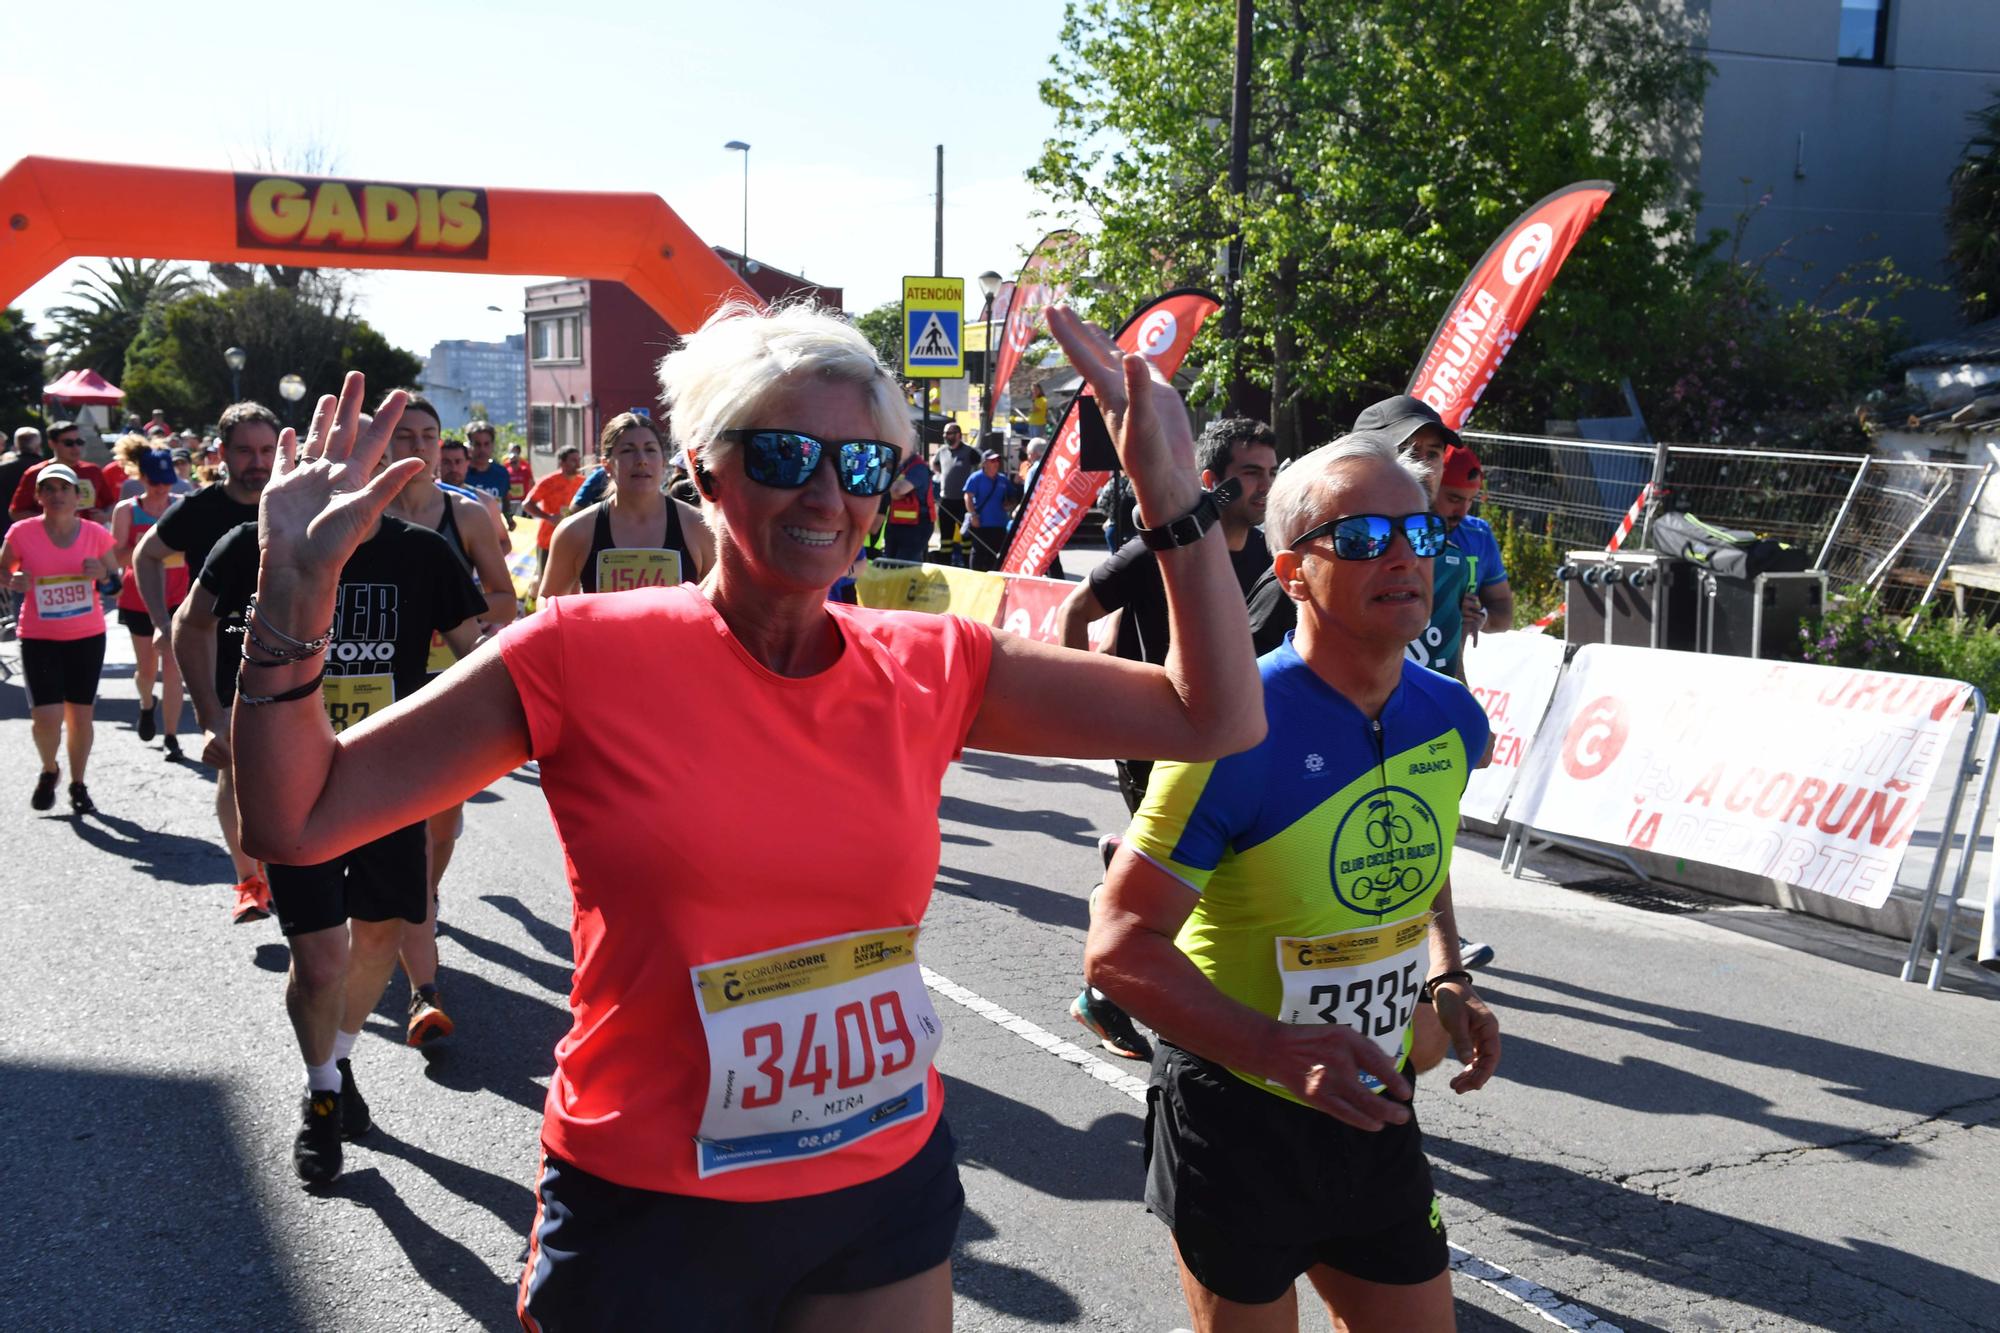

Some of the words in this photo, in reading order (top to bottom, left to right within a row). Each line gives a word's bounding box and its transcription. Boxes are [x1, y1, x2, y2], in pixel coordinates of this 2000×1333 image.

[248, 178, 483, 250] GADIS
[906, 286, 962, 301] ATENCIÓN
[611, 568, 666, 592] 1544
[42, 585, 86, 606] 3399
[1409, 759, 1453, 775] ABANCA
[1683, 761, 1727, 807] A
[1341, 857, 1364, 874] CLUB
[1367, 848, 1405, 867] CICLISTA
[1407, 843, 1436, 860] RIAZOR
[742, 953, 827, 980] CORUÑACORRE
[757, 981, 791, 995] EDICIÓN
[1309, 960, 1418, 1037] 3335
[741, 990, 916, 1110] 3409
[791, 1109, 809, 1122] P.
[824, 1093, 864, 1116] MIRA
[798, 1130, 842, 1149] 08.05
